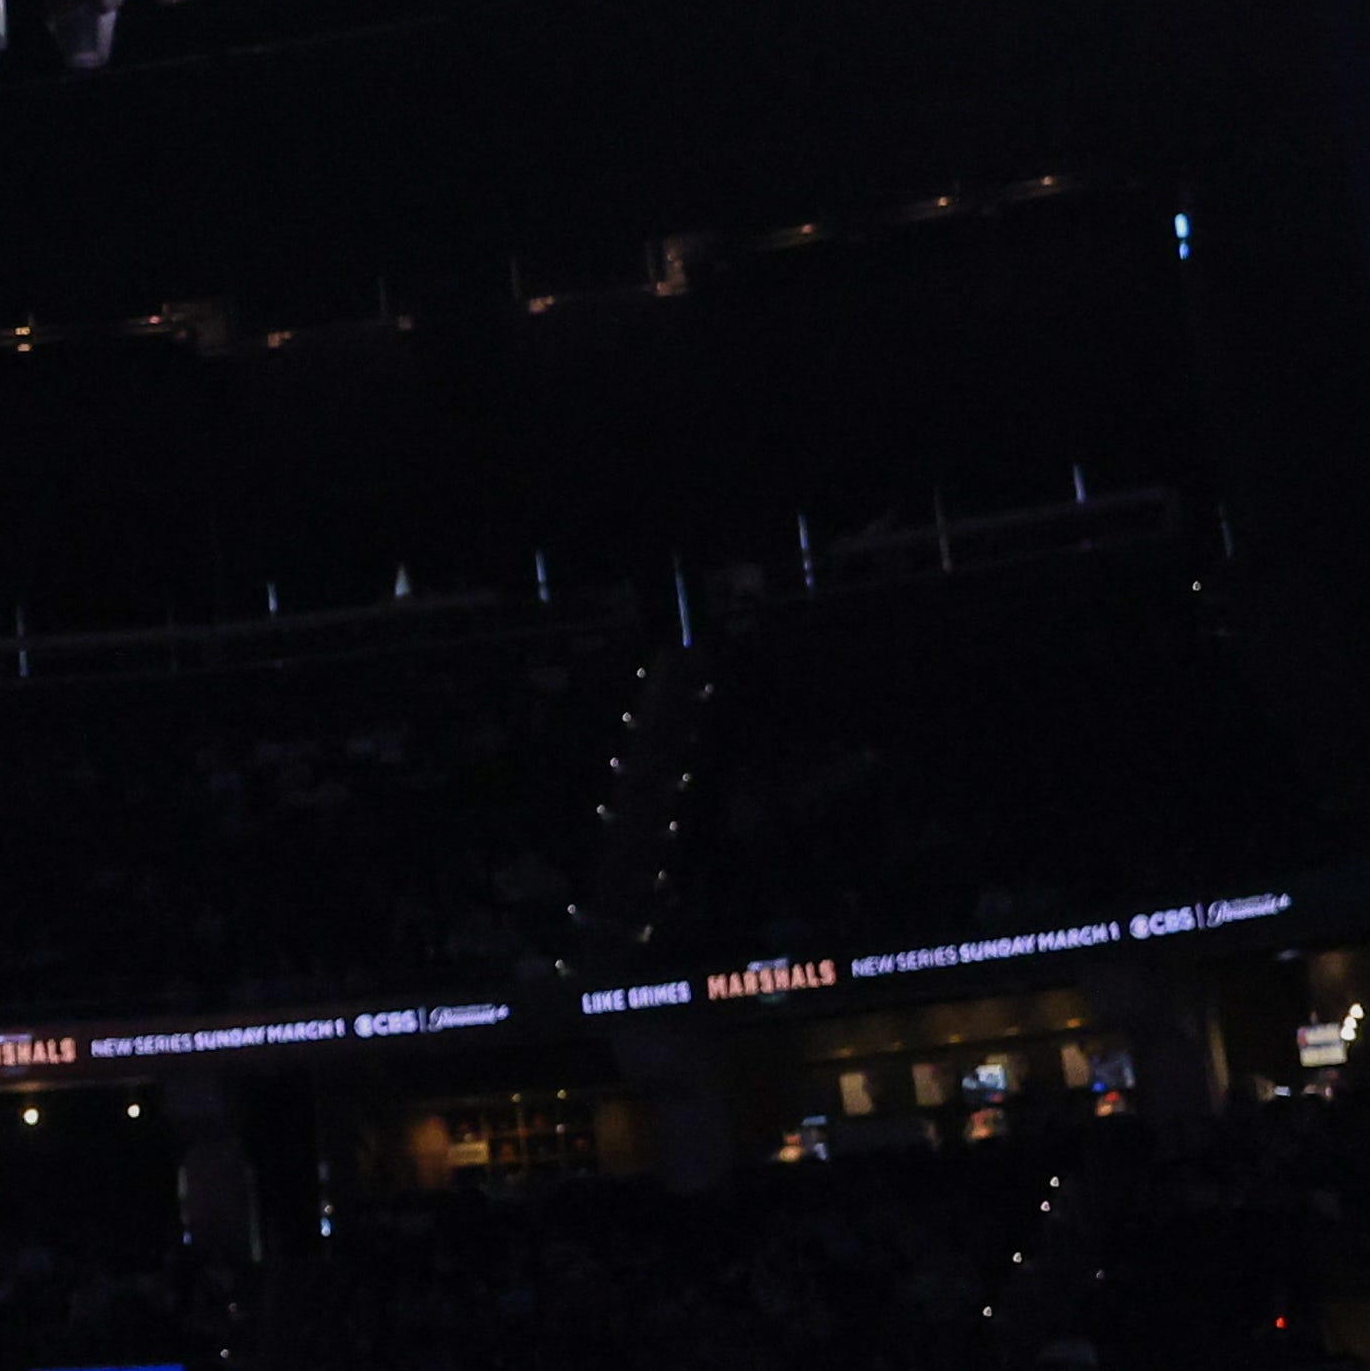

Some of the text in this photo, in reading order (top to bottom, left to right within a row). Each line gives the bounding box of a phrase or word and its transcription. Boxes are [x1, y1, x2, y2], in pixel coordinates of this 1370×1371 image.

[1149, 906, 1196, 935] CBS
[851, 954, 895, 978] NEW
[895, 944, 958, 972] SERIES
[959, 934, 1036, 963] SUNDAY
[1037, 923, 1109, 952] MARCH
[707, 959, 836, 1000] MARSHALS
[91, 1038, 133, 1058] NEW
[134, 1033, 193, 1055] SERIES
[194, 1026, 266, 1051] SUNDAY
[267, 1019, 335, 1043] MARCH
[372, 1009, 419, 1036] CBS
